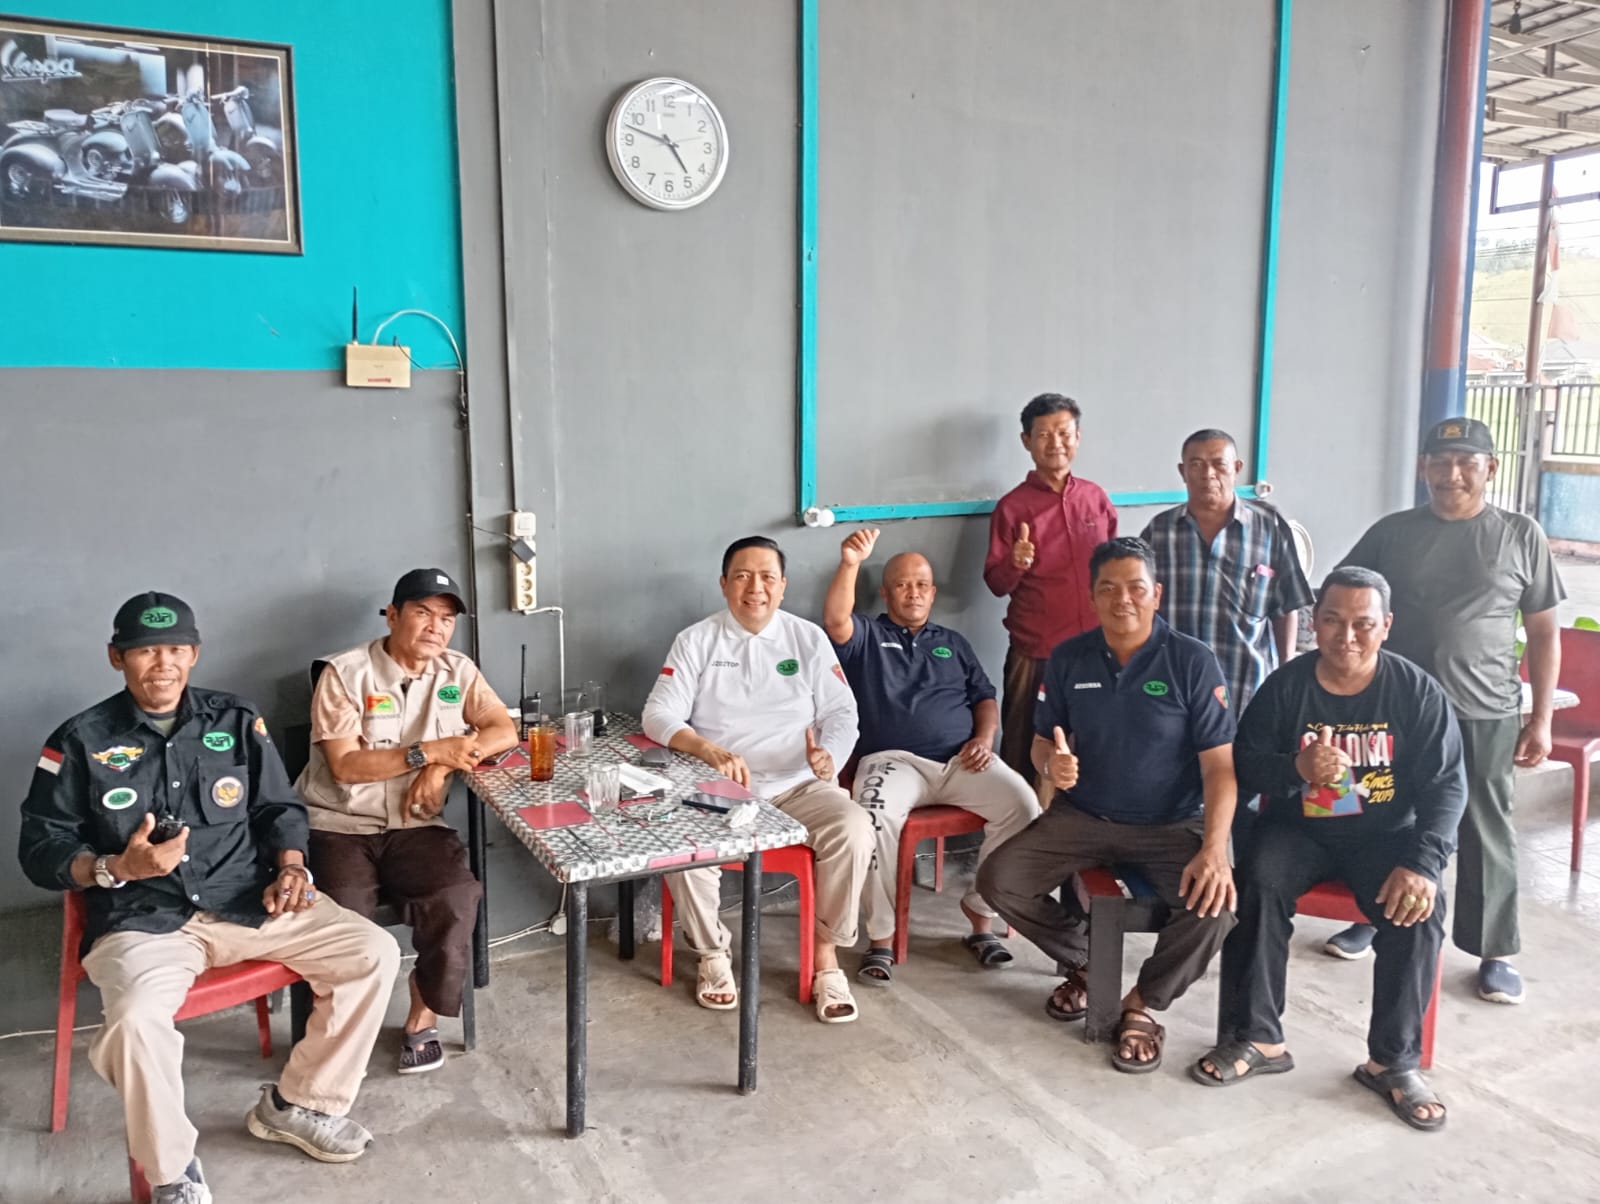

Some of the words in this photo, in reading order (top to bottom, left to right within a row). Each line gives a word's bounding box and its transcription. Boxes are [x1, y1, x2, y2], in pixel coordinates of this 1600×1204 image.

[1, 40, 80, 84] Vespa
[646, 99, 655, 112] 11
[663, 95, 676, 108] 12
[632, 113, 645, 126] 10
[697, 120, 706, 133] 2
[625, 133, 634, 146] 9
[703, 142, 712, 154] 3
[631, 156, 640, 168] 8
[698, 163, 705, 175] 4
[647, 172, 656, 185] 7
[683, 176, 692, 188] 5
[664, 180, 674, 192] 6
[1303, 731, 1391, 767] SOKA
[1368, 788, 1396, 804] 2019
[859, 775, 886, 871] adids
